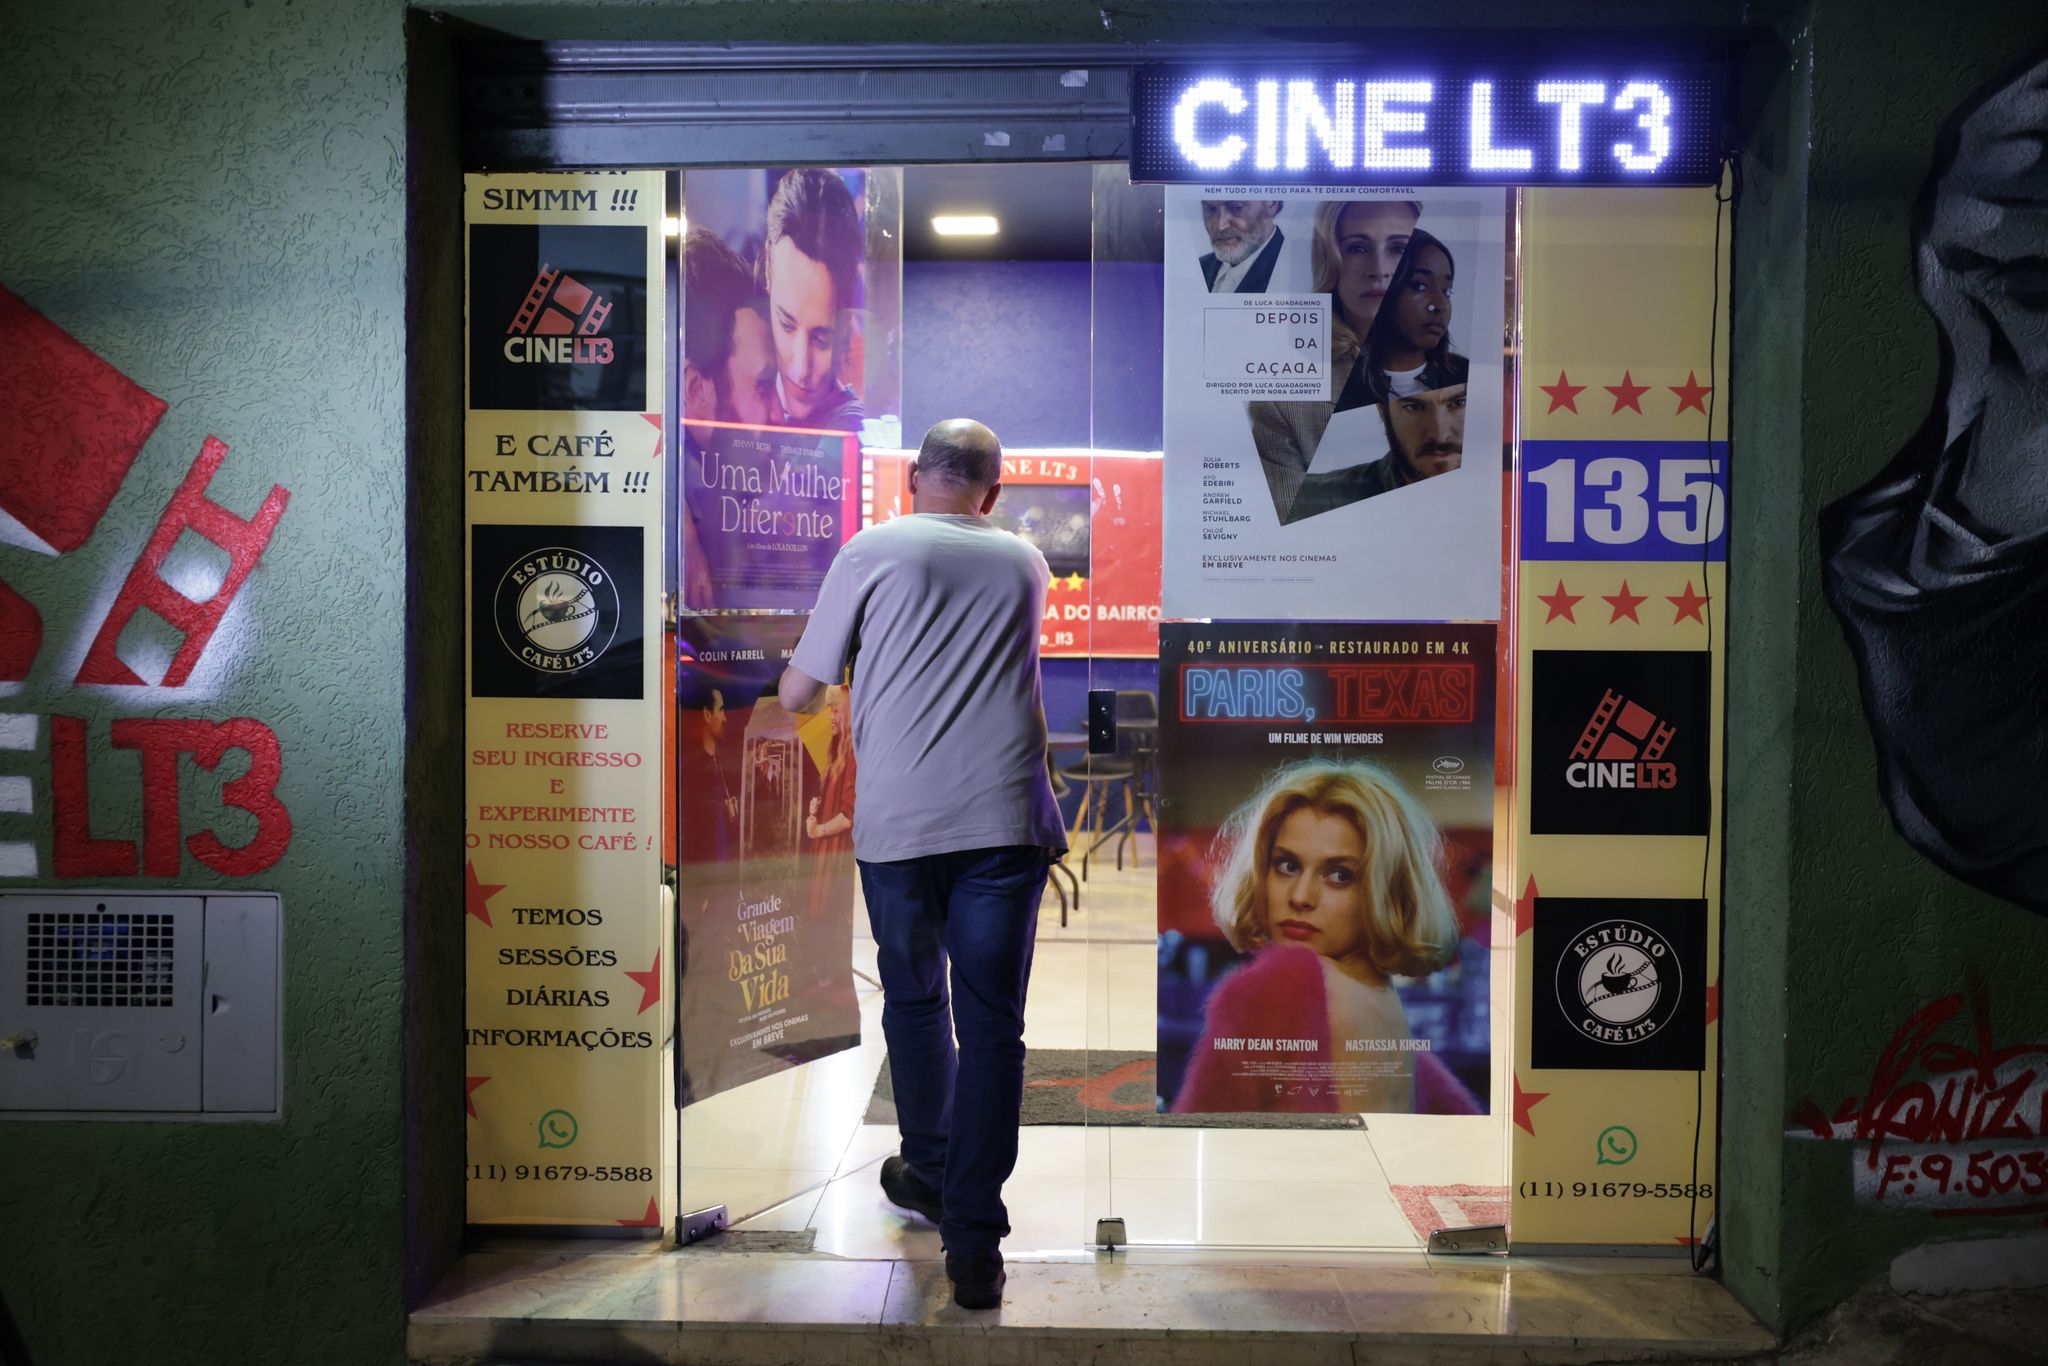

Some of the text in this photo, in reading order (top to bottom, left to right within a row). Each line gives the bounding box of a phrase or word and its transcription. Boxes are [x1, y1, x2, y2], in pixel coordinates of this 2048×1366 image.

[1173, 79, 1671, 170] CINE LT3
[483, 188, 638, 211] SIMMM !!!
[1256, 312, 1318, 324] DEPOIS
[1295, 338, 1318, 349] DA
[1245, 362, 1318, 376] CAÇADA
[495, 430, 615, 458] E CAFÉ
[468, 466, 649, 494] TAMBÉM !!!
[701, 451, 851, 501] Uma Mulher
[1004, 459, 1078, 481] NE LT3
[1528, 458, 1724, 544] 135
[721, 496, 833, 538] Diferente
[512, 552, 603, 586] ESTÚDIO
[1064, 604, 1090, 620] DO
[1098, 604, 1162, 621] BAIRRO
[522, 646, 595, 669] CAFÉ LT3
[700, 650, 764, 662] COLIN FARRELL
[1219, 638, 1312, 654] ANIVERSÁRIO
[1330, 641, 1419, 655] RESTAURADO
[1426, 641, 1445, 655] EM
[1452, 641, 1469, 655] 4K
[1186, 668, 1466, 722] PARIS, TEXAS
[505, 723, 608, 740] RESERVE
[1268, 732, 1384, 744] UM FILME DE WIM WENDERS
[472, 750, 642, 768] SEU INGRESSO
[550, 779, 564, 794] E
[478, 806, 636, 824] EXPERIMENTE
[466, 831, 652, 851] O NOSSO CAFÉ !
[512, 908, 604, 926] TEMOS
[737, 894, 782, 921] Grande
[737, 915, 794, 946] Viagem
[1574, 924, 1666, 958] ESTÚDIO
[498, 946, 618, 967] SESSÕES
[729, 942, 788, 982] Da Sua
[506, 986, 610, 1008] DIÁRIAS
[739, 969, 790, 1012] Vida
[465, 1027, 654, 1051] INFORMAÇÕES
[763, 1029, 784, 1045] BREVE
[1582, 1018, 1657, 1042] CAFÉ LT3
[1214, 1038, 1431, 1052] HARRY DEAN STANTON NASTASSJA KINSKI
[514, 1165, 654, 1182] 91679-5588
[1519, 1182, 1713, 1200] (11) 91679-5588
